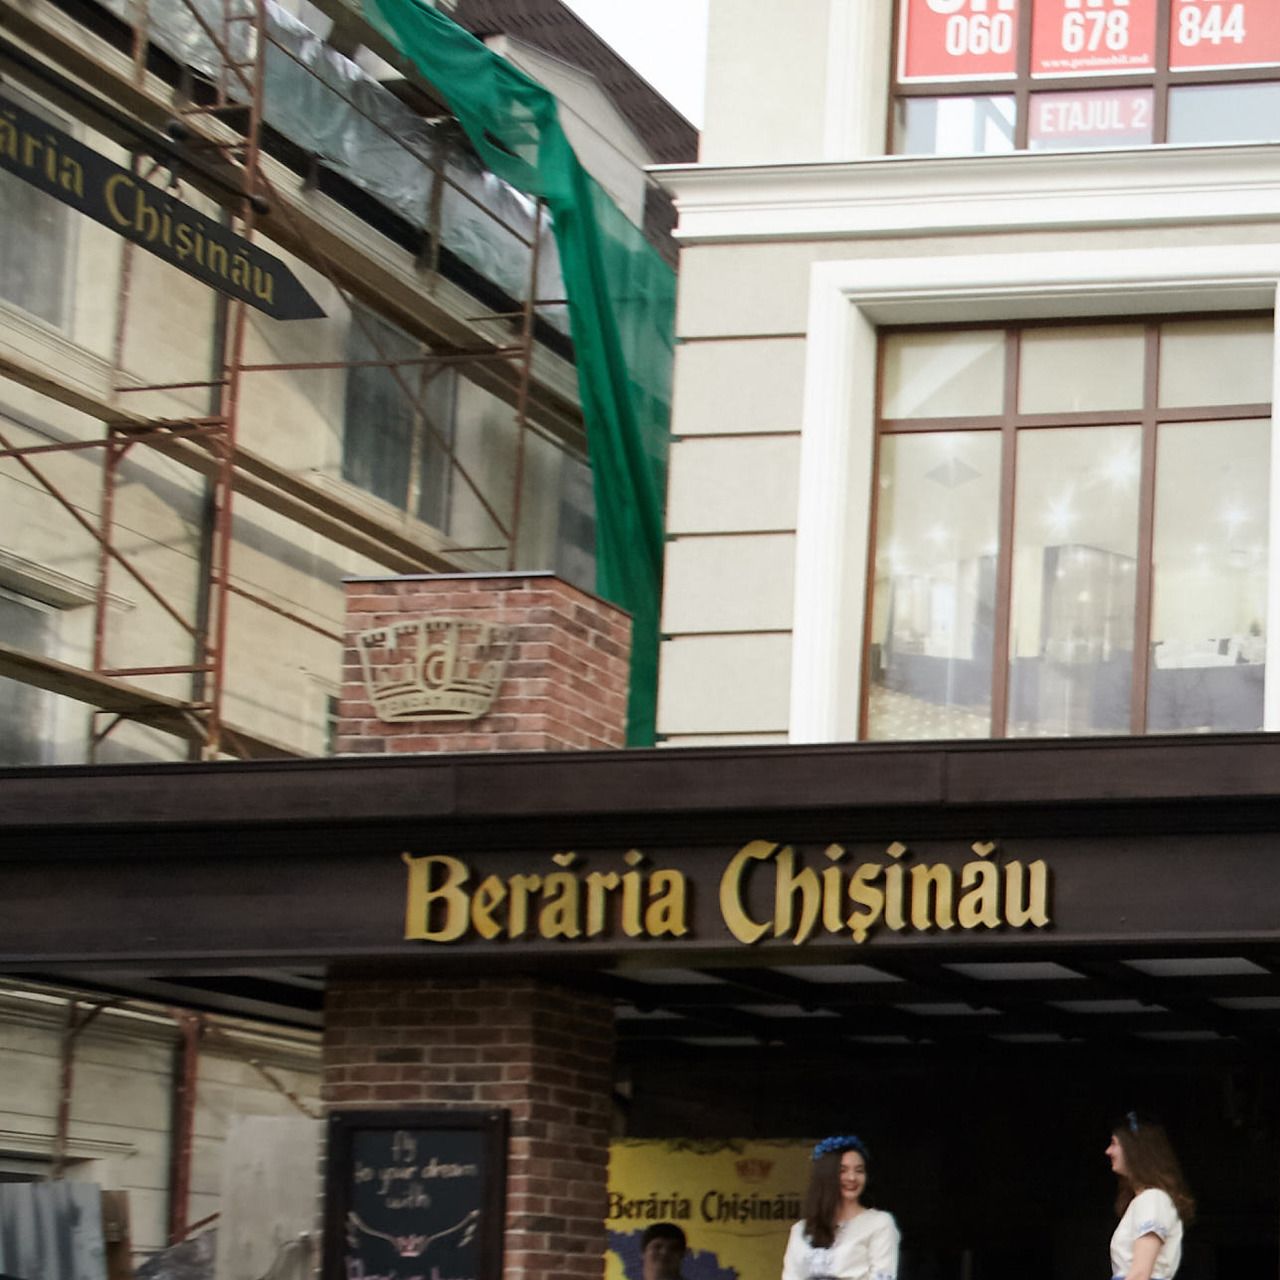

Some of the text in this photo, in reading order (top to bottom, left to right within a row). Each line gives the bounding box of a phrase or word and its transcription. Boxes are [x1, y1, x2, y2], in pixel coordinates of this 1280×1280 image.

[945, 4, 1246, 56] 060 678 844
[1039, 98, 1148, 133] ETAJUL 2
[103, 171, 275, 305] Chișinău
[401, 839, 1050, 946] Berăria Chișinău
[607, 1190, 691, 1220] Berăria
